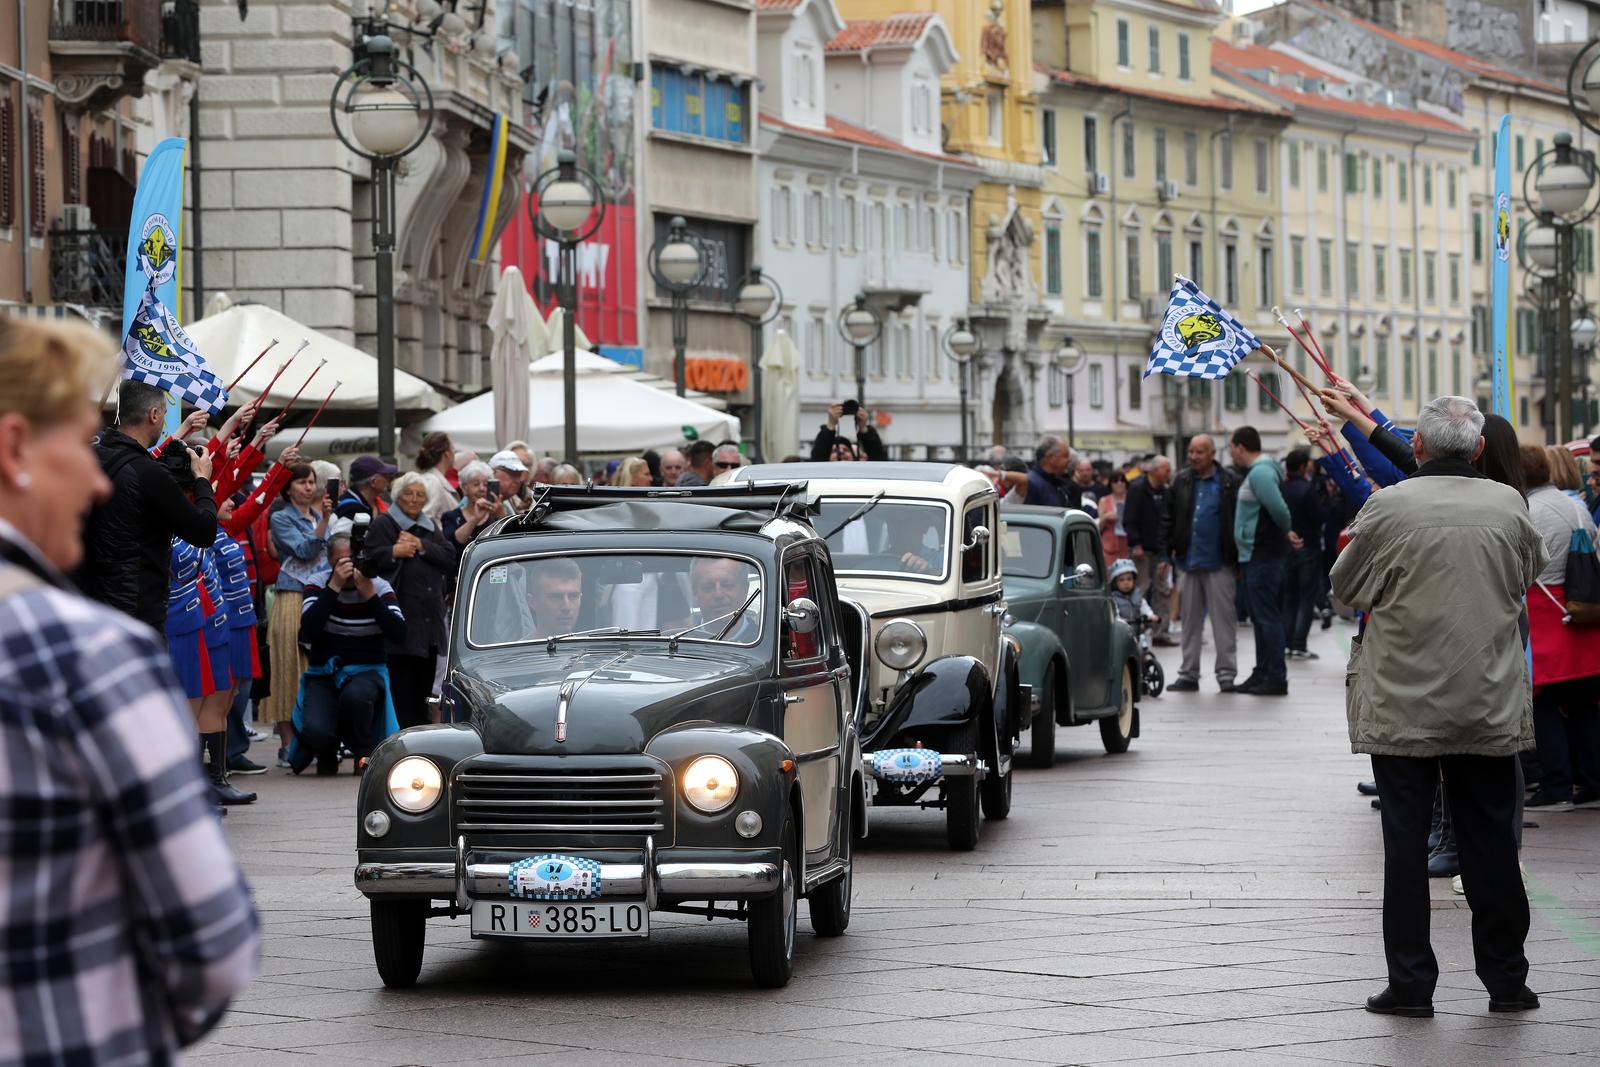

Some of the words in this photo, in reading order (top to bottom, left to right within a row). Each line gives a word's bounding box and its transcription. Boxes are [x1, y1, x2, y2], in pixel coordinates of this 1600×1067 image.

[131, 348, 153, 368] RIJEKA
[157, 363, 185, 372] 1996.
[491, 904, 518, 931] RI
[545, 904, 642, 933] 385-LO
